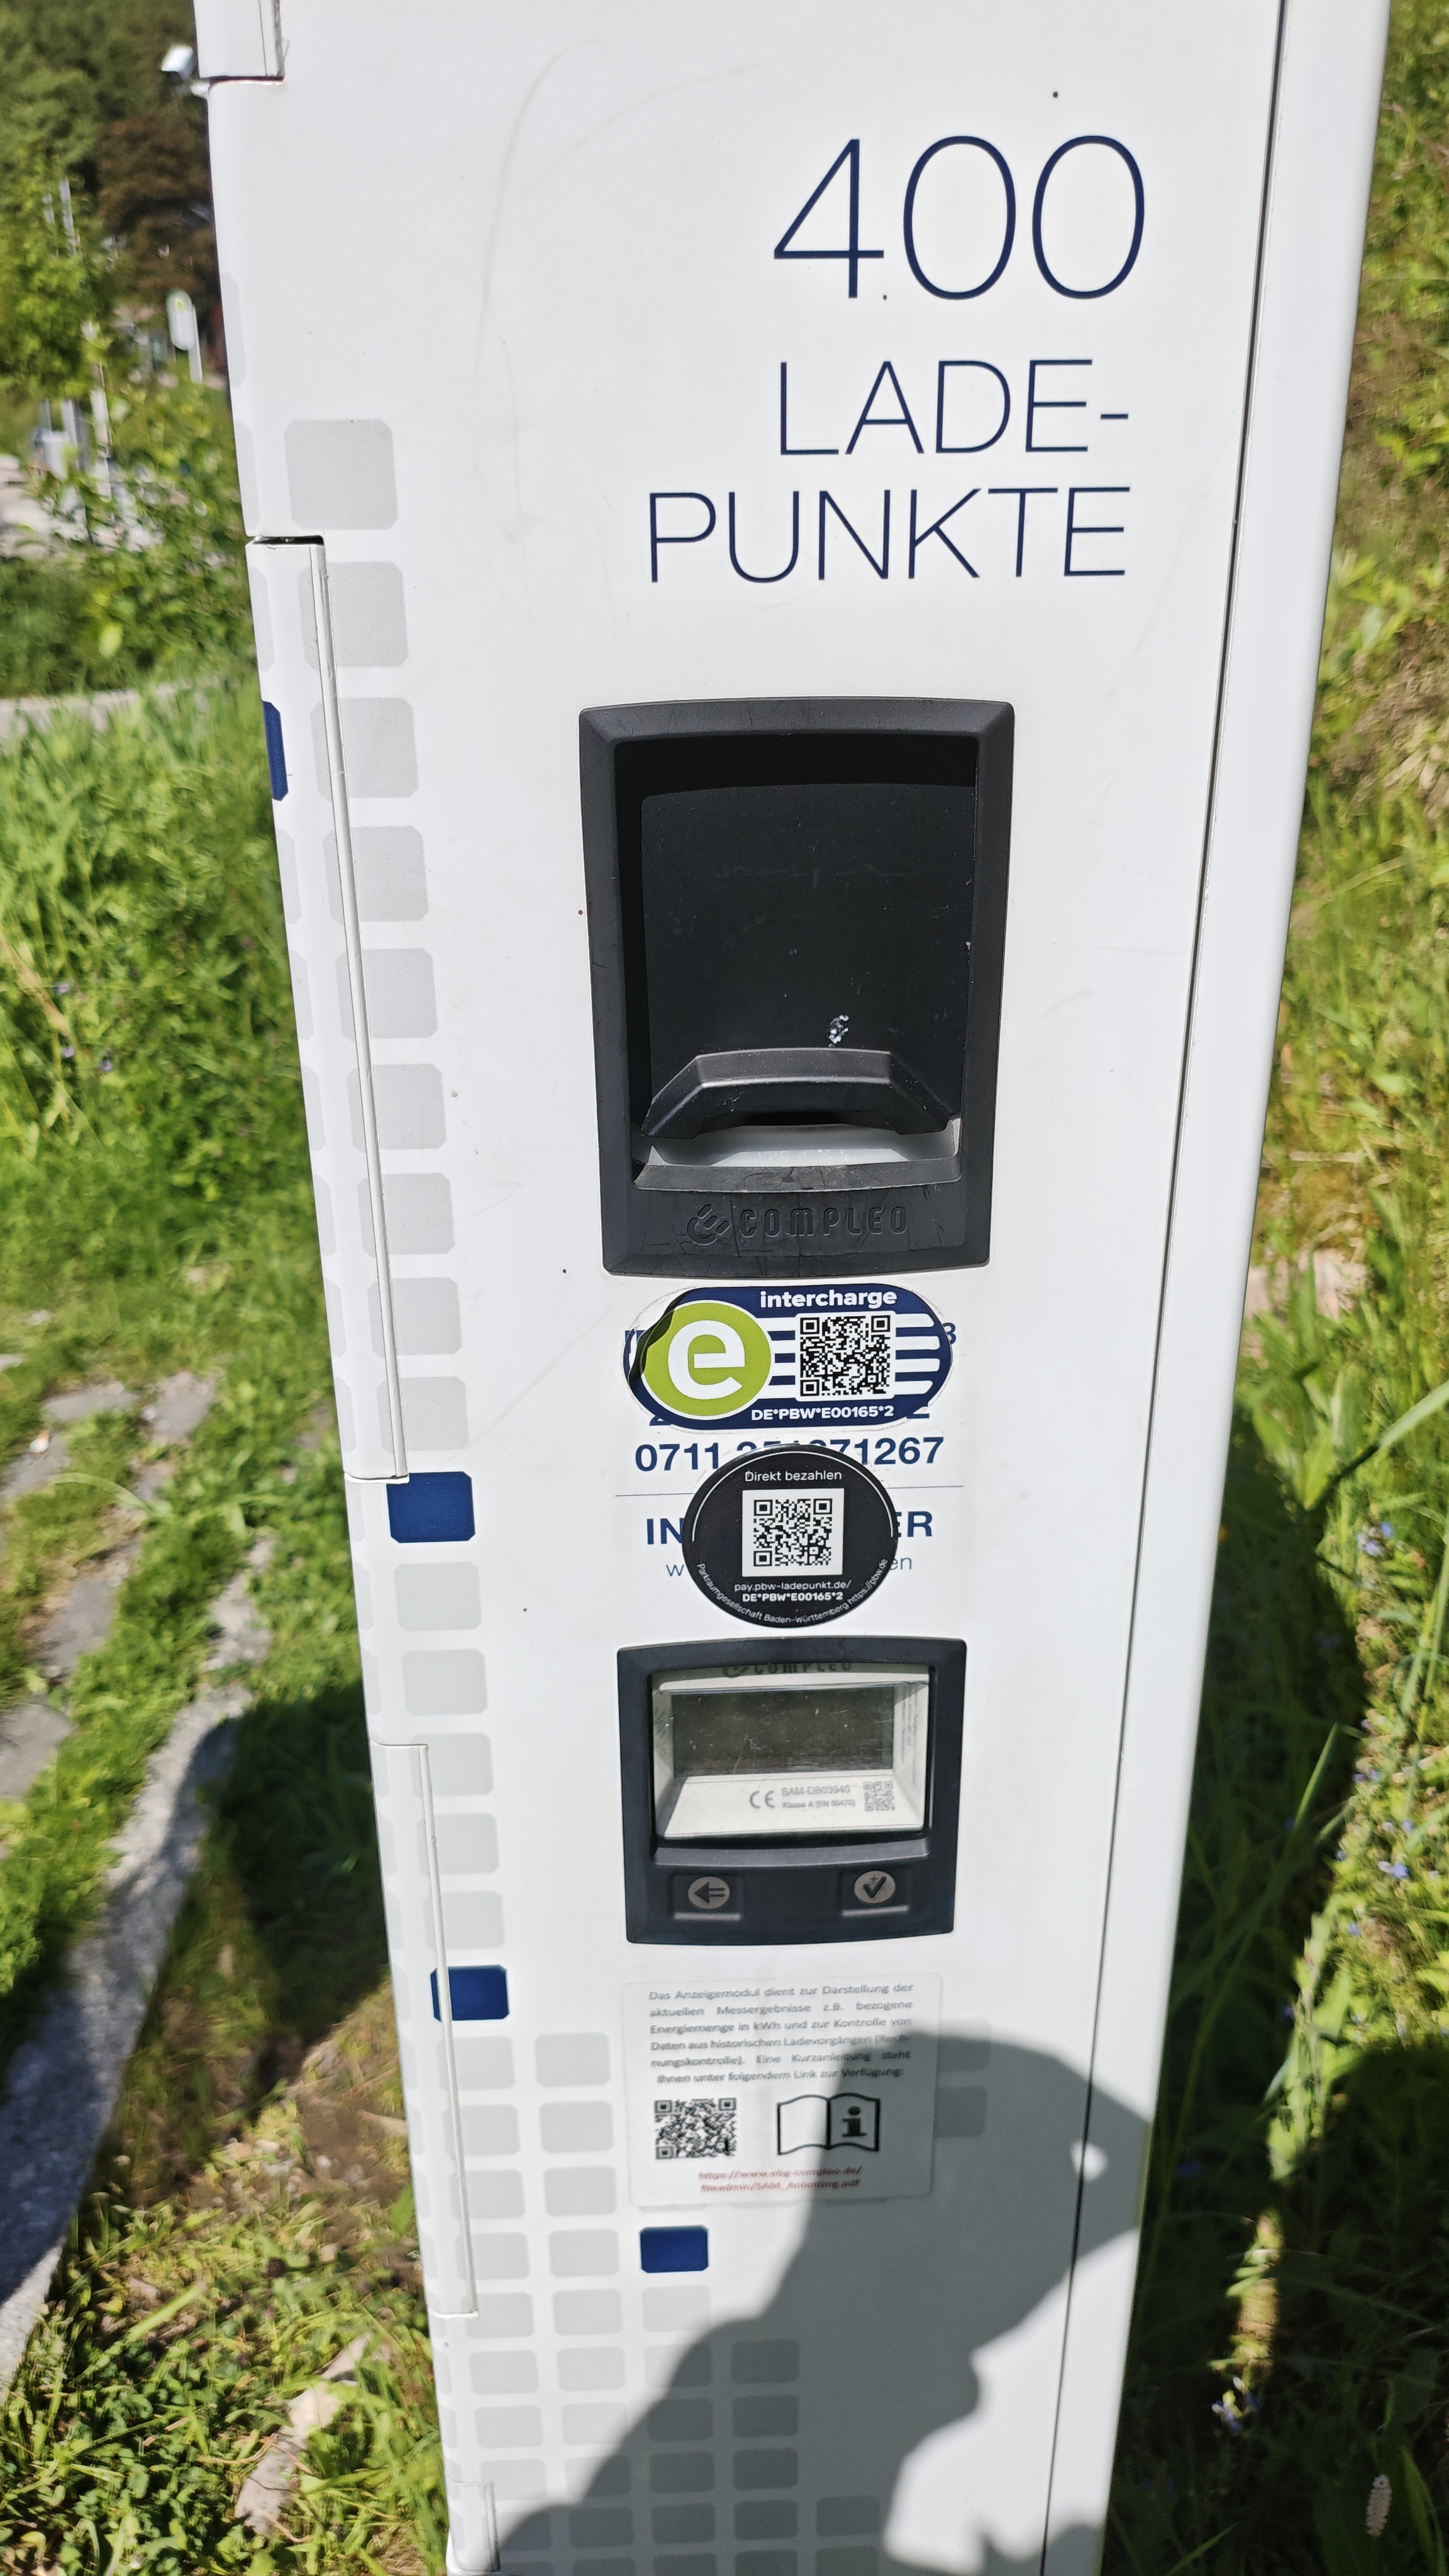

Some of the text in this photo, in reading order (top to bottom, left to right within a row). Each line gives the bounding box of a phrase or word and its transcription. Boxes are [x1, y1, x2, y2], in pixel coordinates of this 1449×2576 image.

[774, 135, 1145, 301] 400
[780, 359, 1129, 455] LADE-
[650, 486, 1130, 584] PUNKTE
[740, 1206, 907, 1238] COMPLEO
[760, 1289, 897, 1309] intercharge
[635, 1443, 719, 1472] 0711
[745, 1470, 842, 1482] Direkt bezahlen
[697, 1558, 888, 1623] Parkraumgesellschaft Baden-Württemberg https://pbw.de
[735, 1579, 852, 1592] pay.pbw-ladepunkt.de/
[649, 1991, 671, 2000] Das
[674, 1987, 760, 2000] Anzeigemodul
[763, 1987, 795, 1996] dient
[822, 1984, 890, 1994] Darstellung
[893, 1983, 914, 1992] der
[649, 2001, 913, 2017] aktuellen Messergebnisse z.B. bezogene
[650, 2024, 735, 2035] Energiemenge
[738, 2023, 750, 2031] in
[753, 2021, 781, 2030] kWh
[784, 2020, 808, 2029] und
[833, 2018, 887, 2028] Kontrolle
[890, 2018, 912, 2026] von
[650, 2041, 687, 2051] Daten
[710, 2038, 782, 2049] historischen
[756, 2055, 782, 2063] Eine
[728, 2071, 791, 2082] folgendem
[794, 2070, 818, 2079] Link
